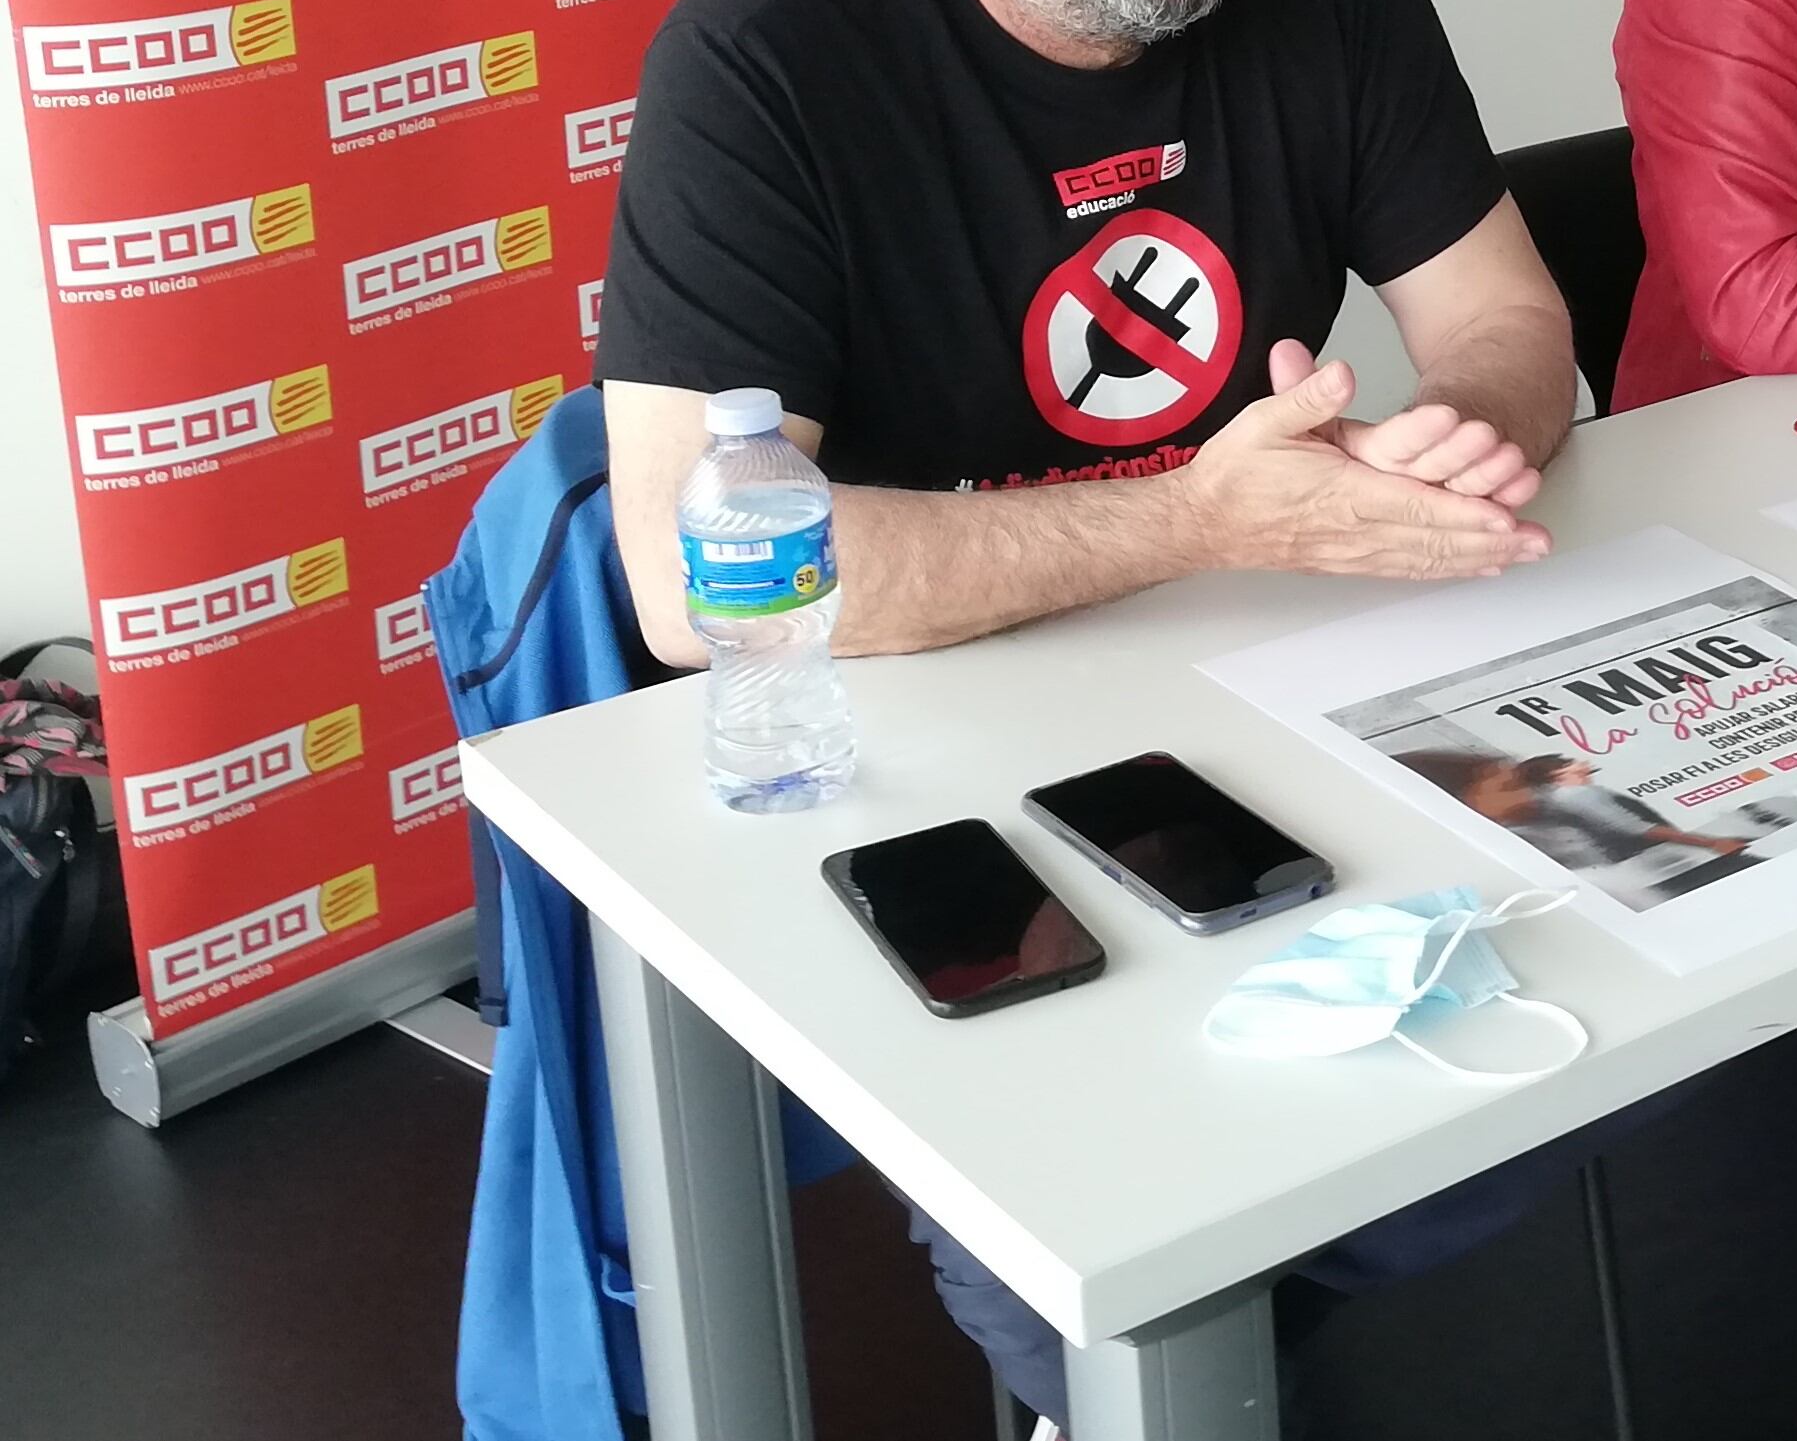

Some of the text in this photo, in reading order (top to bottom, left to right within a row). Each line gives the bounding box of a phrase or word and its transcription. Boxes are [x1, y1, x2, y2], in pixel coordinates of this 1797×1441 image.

[42, 26, 217, 75] CCOO
[33, 92, 90, 108] terres
[95, 88, 119, 105] de
[124, 84, 175, 103] lleida
[340, 60, 468, 121] CCOO
[1065, 157, 1155, 195] CCOO
[1066, 189, 1136, 219] educació
[68, 217, 237, 272] CCOO
[59, 288, 116, 303] terres
[121, 284, 145, 299] de
[149, 276, 198, 295] lleida
[357, 238, 485, 303] CCOO
[95, 400, 256, 460] CCOO
[374, 408, 500, 476] CCOO
[119, 576, 275, 641] CCOO
[1562, 635, 1774, 715] MAIG
[1560, 715, 1638, 754] la
[1694, 711, 1755, 737] APUJAR
[1708, 717, 1788, 749] CONTENIR
[144, 745, 291, 816] CCOO
[1627, 771, 1690, 798] POSAR
[1687, 764, 1706, 777] FI
[1702, 760, 1716, 772] A
[1717, 749, 1750, 767] LES
[1681, 778, 1745, 804] CCOO
[166, 907, 308, 983] CCOO
